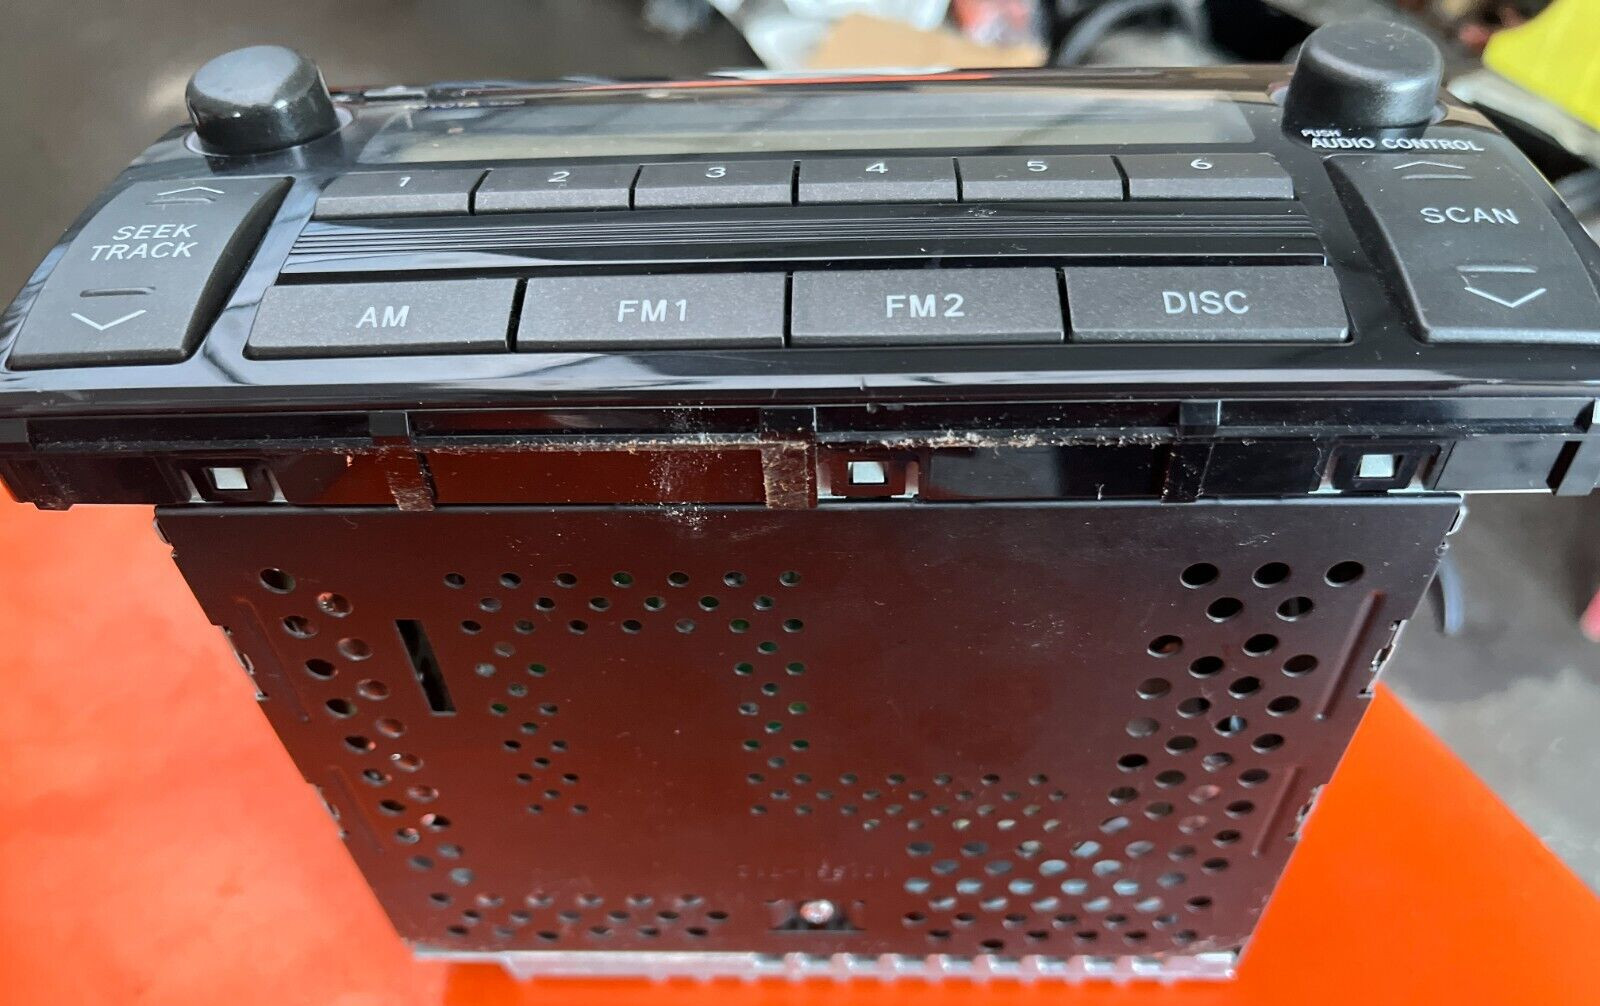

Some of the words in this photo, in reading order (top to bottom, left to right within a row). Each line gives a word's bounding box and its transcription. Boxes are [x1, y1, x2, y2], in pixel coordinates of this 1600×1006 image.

[1301, 128, 1342, 138] PUSH
[1311, 137, 1375, 150] AUDIO
[1381, 138, 1484, 152] CONTROL
[865, 163, 889, 174] 4
[1026, 160, 1048, 172] 5
[1190, 158, 1213, 170] 6
[548, 171, 570, 182] 2
[705, 166, 727, 178] 3
[399, 176, 411, 187] 1
[1420, 207, 1519, 225] SCAN
[112, 224, 197, 241] SEEK
[89, 241, 199, 262] TRACK
[1161, 290, 1250, 315] DISC
[355, 305, 410, 328] AM
